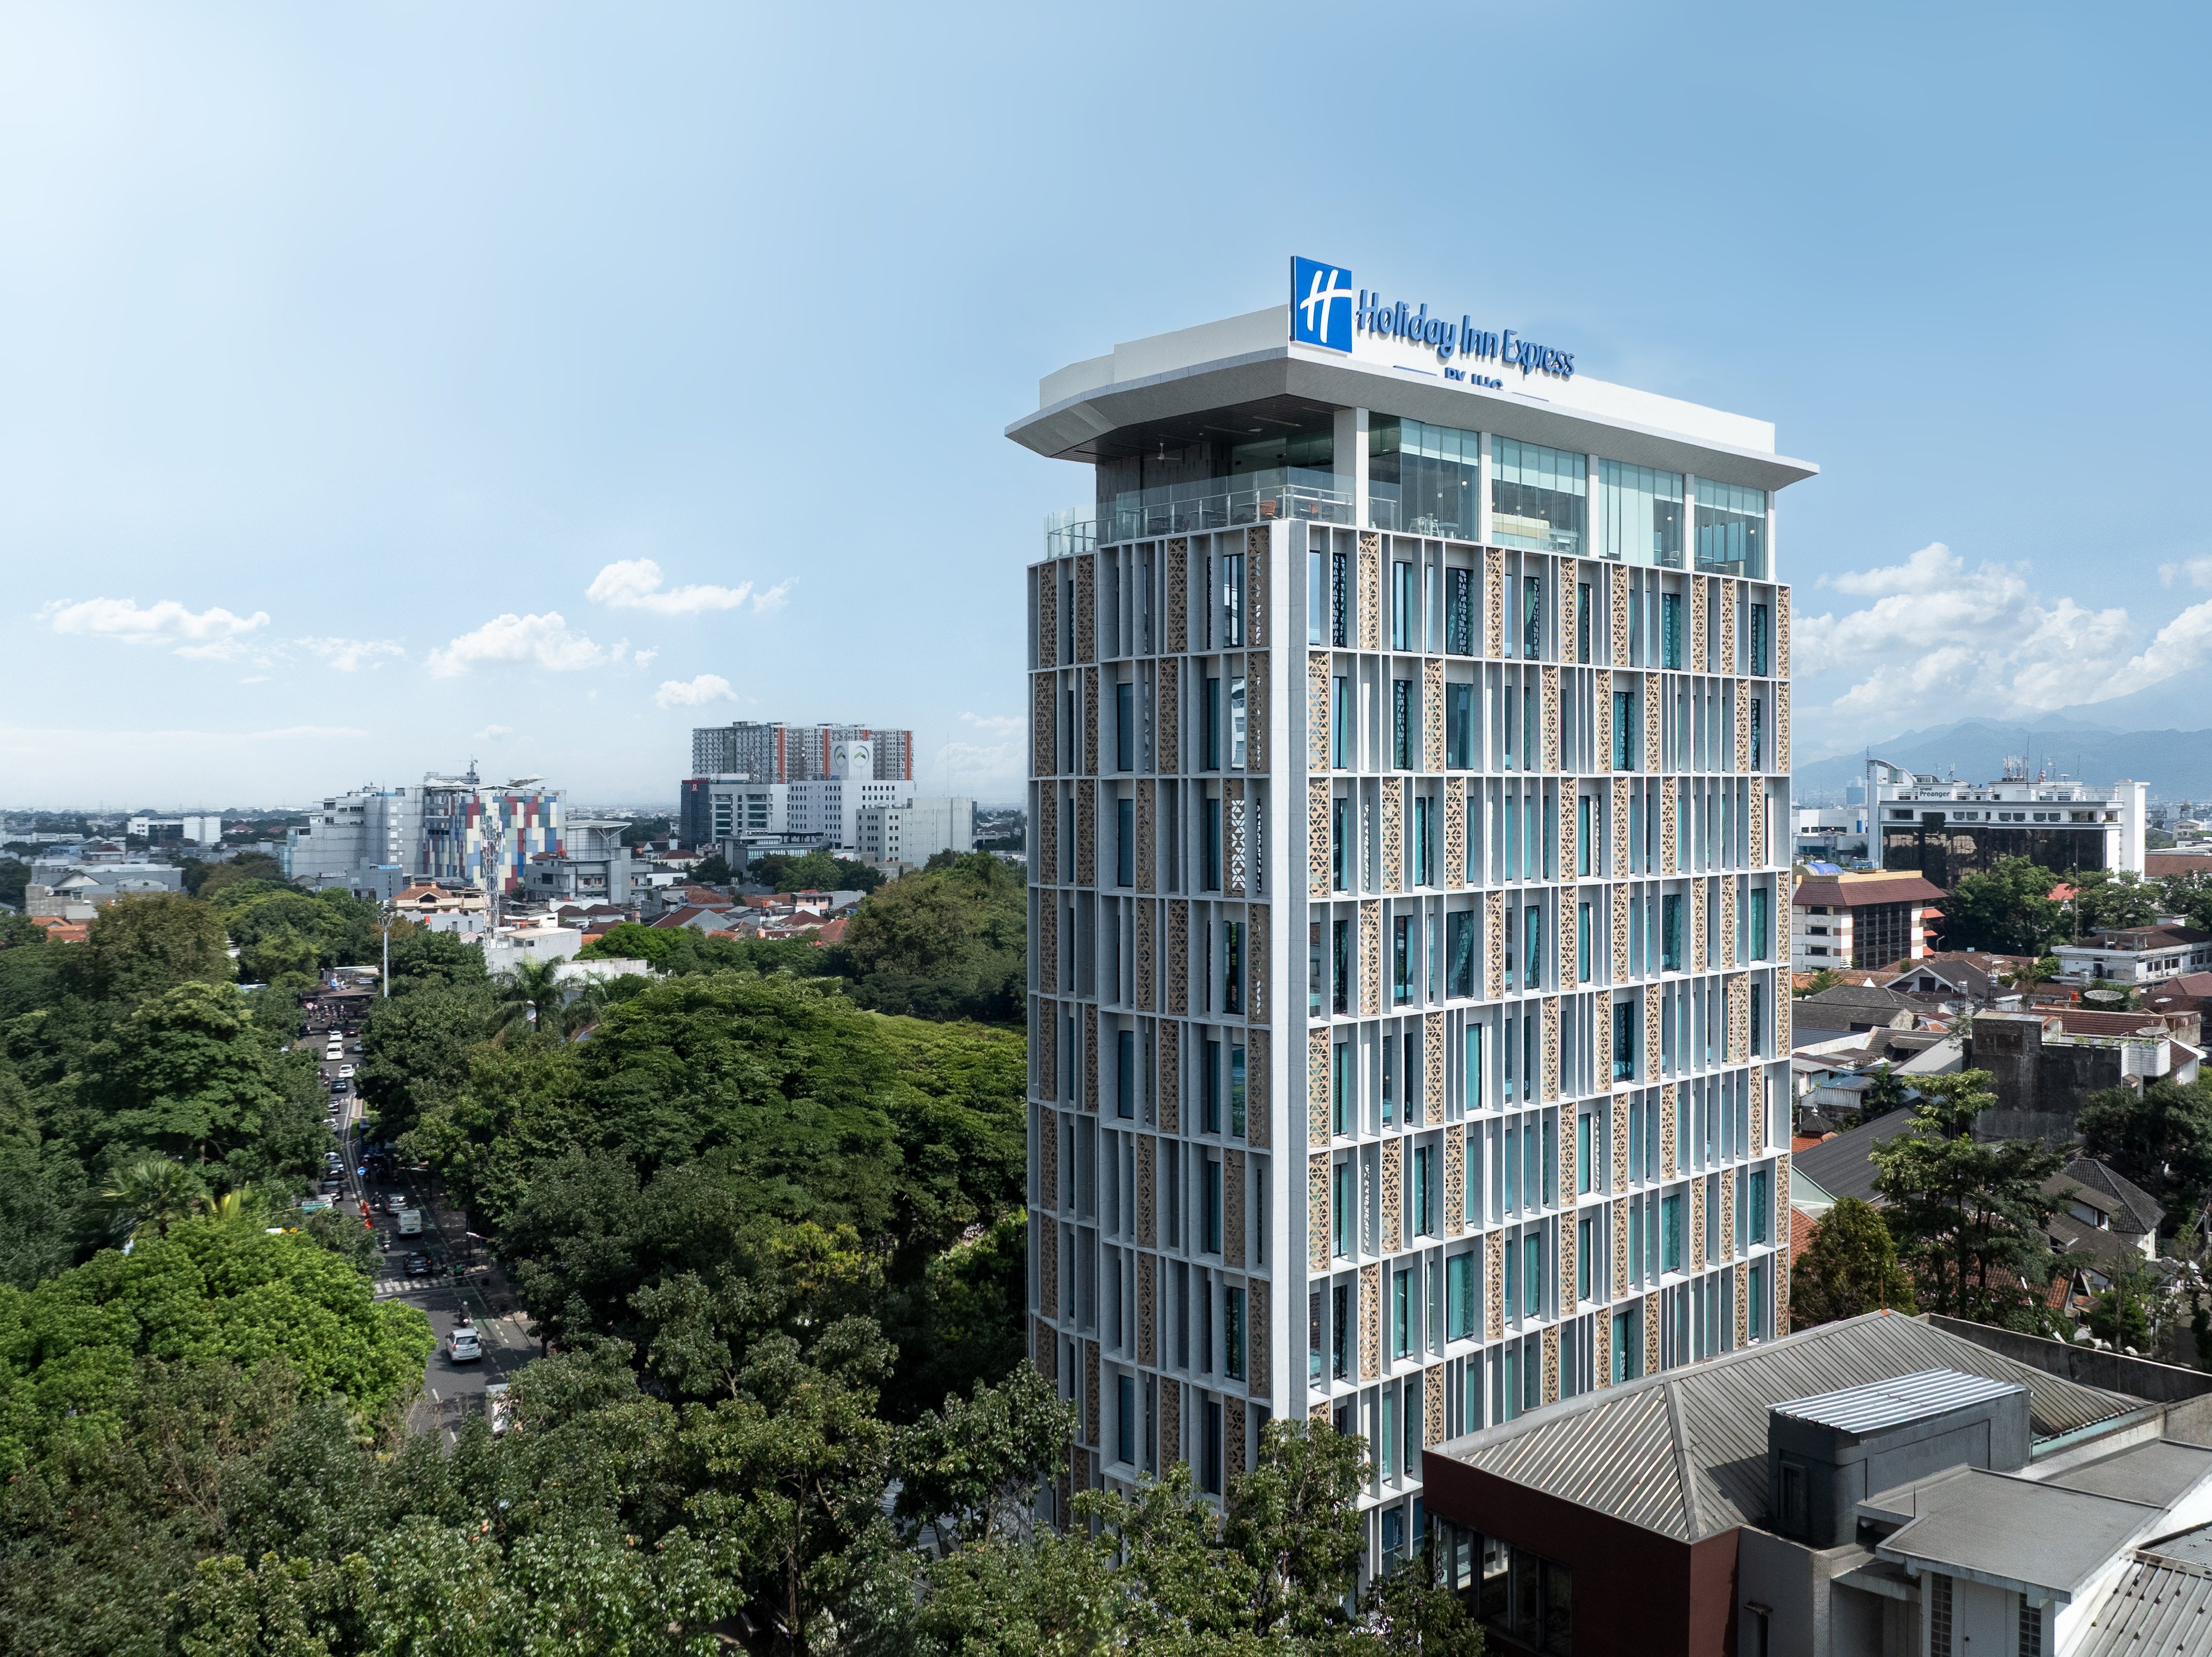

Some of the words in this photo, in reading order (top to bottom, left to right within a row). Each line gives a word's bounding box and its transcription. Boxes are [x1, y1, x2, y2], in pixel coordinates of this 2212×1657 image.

[1356, 289, 1457, 358] Holiday
[1460, 315, 1499, 358] Inn
[1502, 329, 1575, 375] Express
